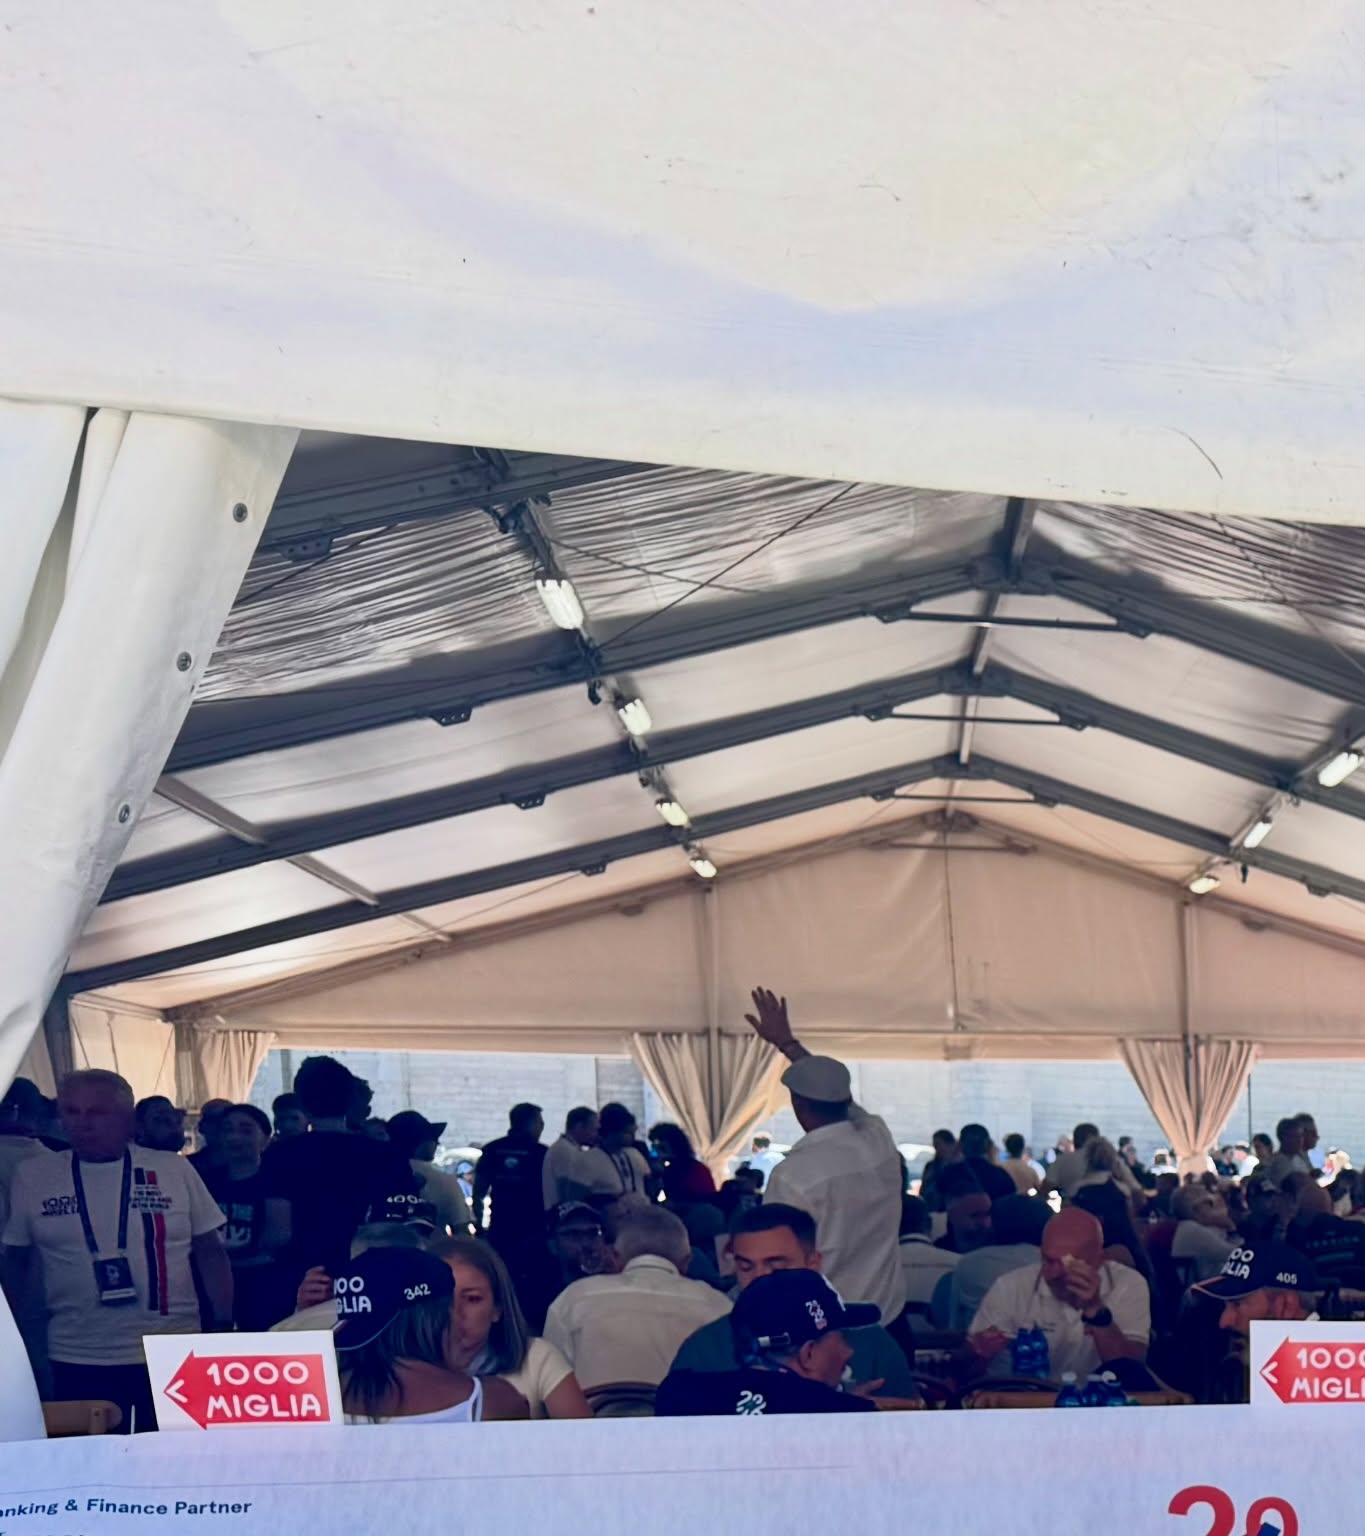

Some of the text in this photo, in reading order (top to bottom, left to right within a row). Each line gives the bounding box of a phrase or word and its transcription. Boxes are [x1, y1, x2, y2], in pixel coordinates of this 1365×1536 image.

[1276, 1272, 1298, 1285] 405
[404, 1284, 431, 1301] 342
[207, 1361, 309, 1386] 1000
[206, 1393, 322, 1419] MIGLIA
[65, 1498, 78, 1512] &
[87, 1498, 168, 1515] Finance
[175, 1500, 252, 1515] Partner
